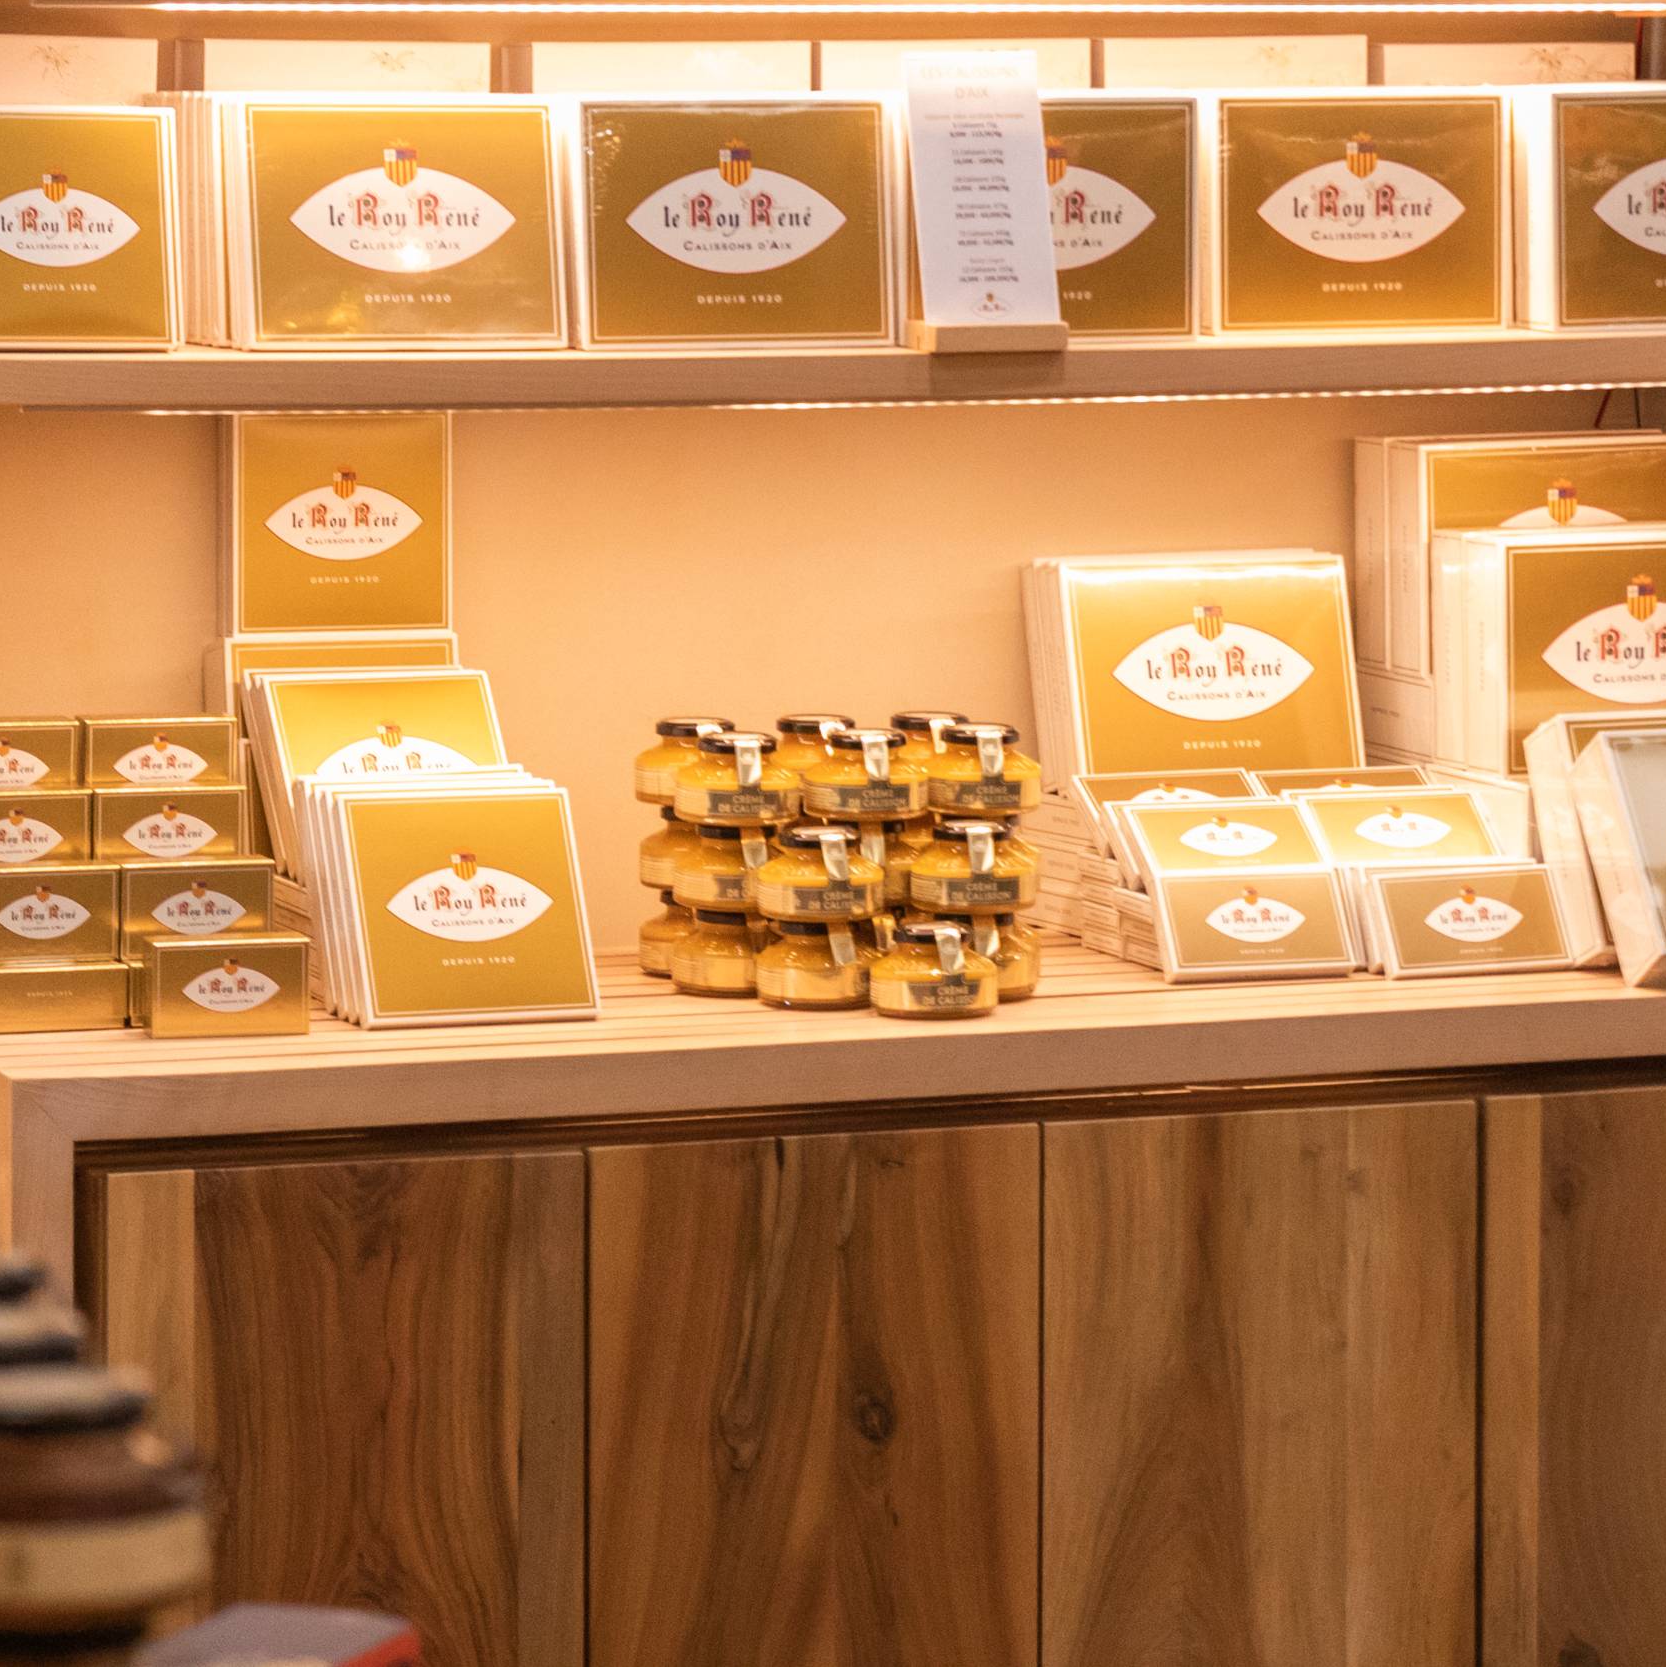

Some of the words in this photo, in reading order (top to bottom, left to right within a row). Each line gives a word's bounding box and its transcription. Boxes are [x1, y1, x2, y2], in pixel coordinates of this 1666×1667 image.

[0, 216, 14, 234] le
[19, 207, 60, 240] Roy
[66, 206, 115, 233] René
[329, 204, 346, 227] le
[355, 192, 407, 236] Roy
[417, 192, 480, 227] René
[663, 206, 681, 228] le
[690, 193, 740, 236] Roy
[750, 193, 812, 228] René
[1064, 190, 1123, 225] René
[1293, 197, 1308, 218] le
[1318, 184, 1365, 226] Roy
[1375, 184, 1433, 218] René
[1627, 194, 1642, 216] le
[310, 503, 347, 534] Roy
[353, 502, 399, 528] René
[1146, 660, 1163, 680] le
[1170, 647, 1217, 688] Roy
[1225, 645, 1282, 677] René
[1575, 642, 1591, 662] le
[1599, 628, 1646, 669] Roy
[434, 885, 473, 916] Roy
[479, 884, 527, 909] René
